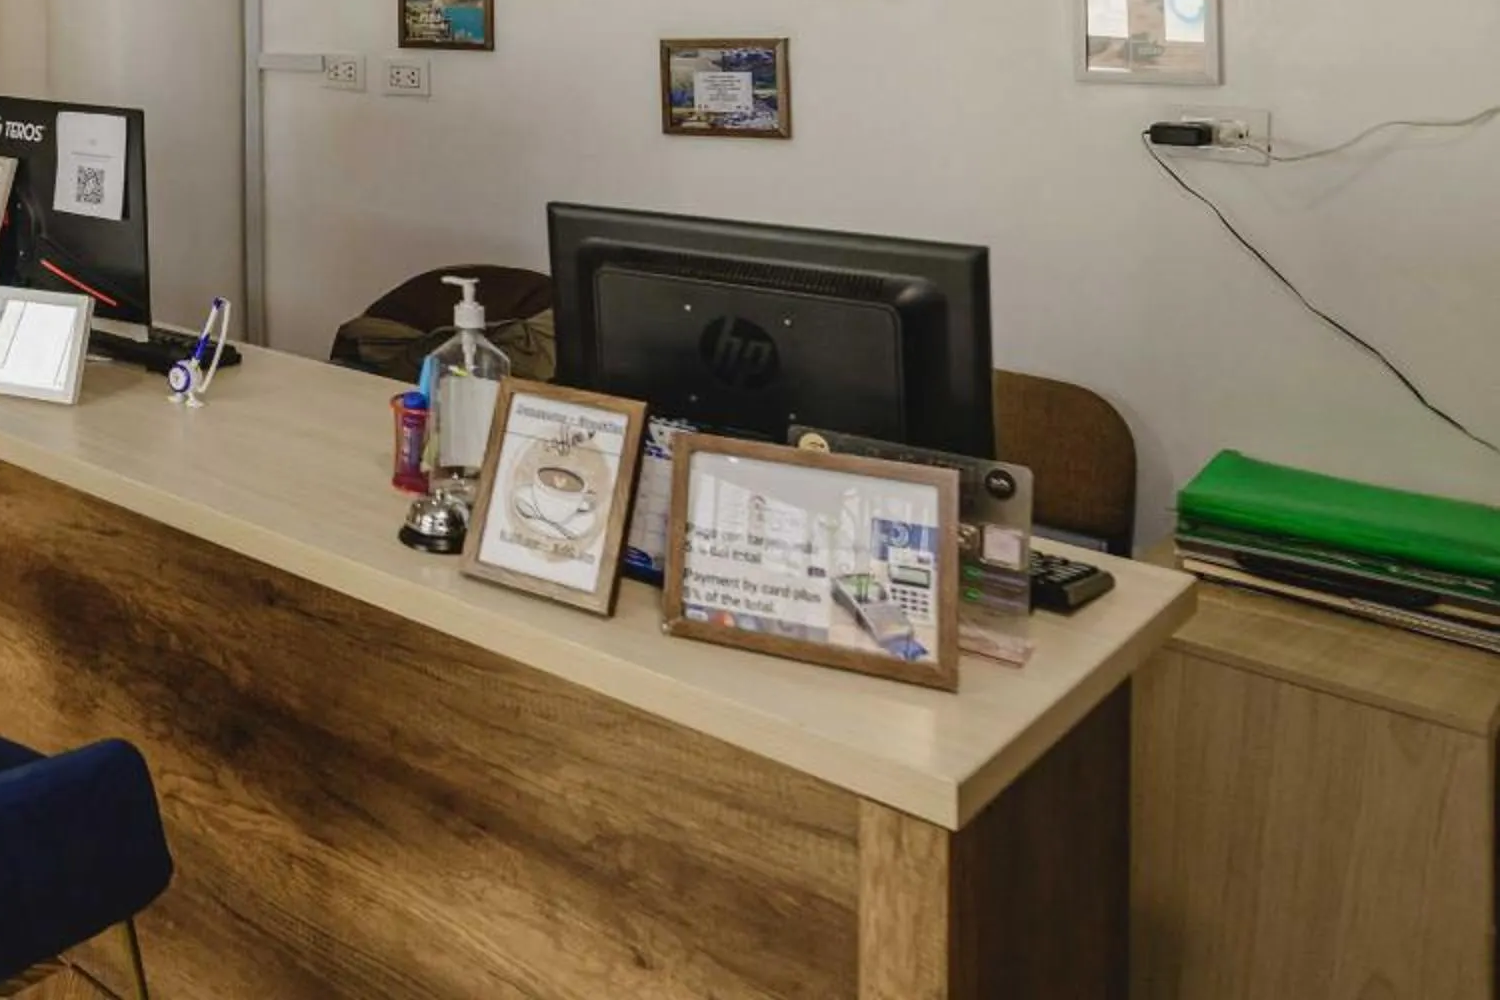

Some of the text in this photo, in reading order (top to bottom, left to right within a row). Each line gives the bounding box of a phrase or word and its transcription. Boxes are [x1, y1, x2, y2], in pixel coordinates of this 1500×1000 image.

[5, 120, 45, 142] TEROS
[713, 315, 774, 388] hp
[683, 567, 740, 592] Payment
[761, 580, 790, 600] card
[792, 585, 822, 606] plus
